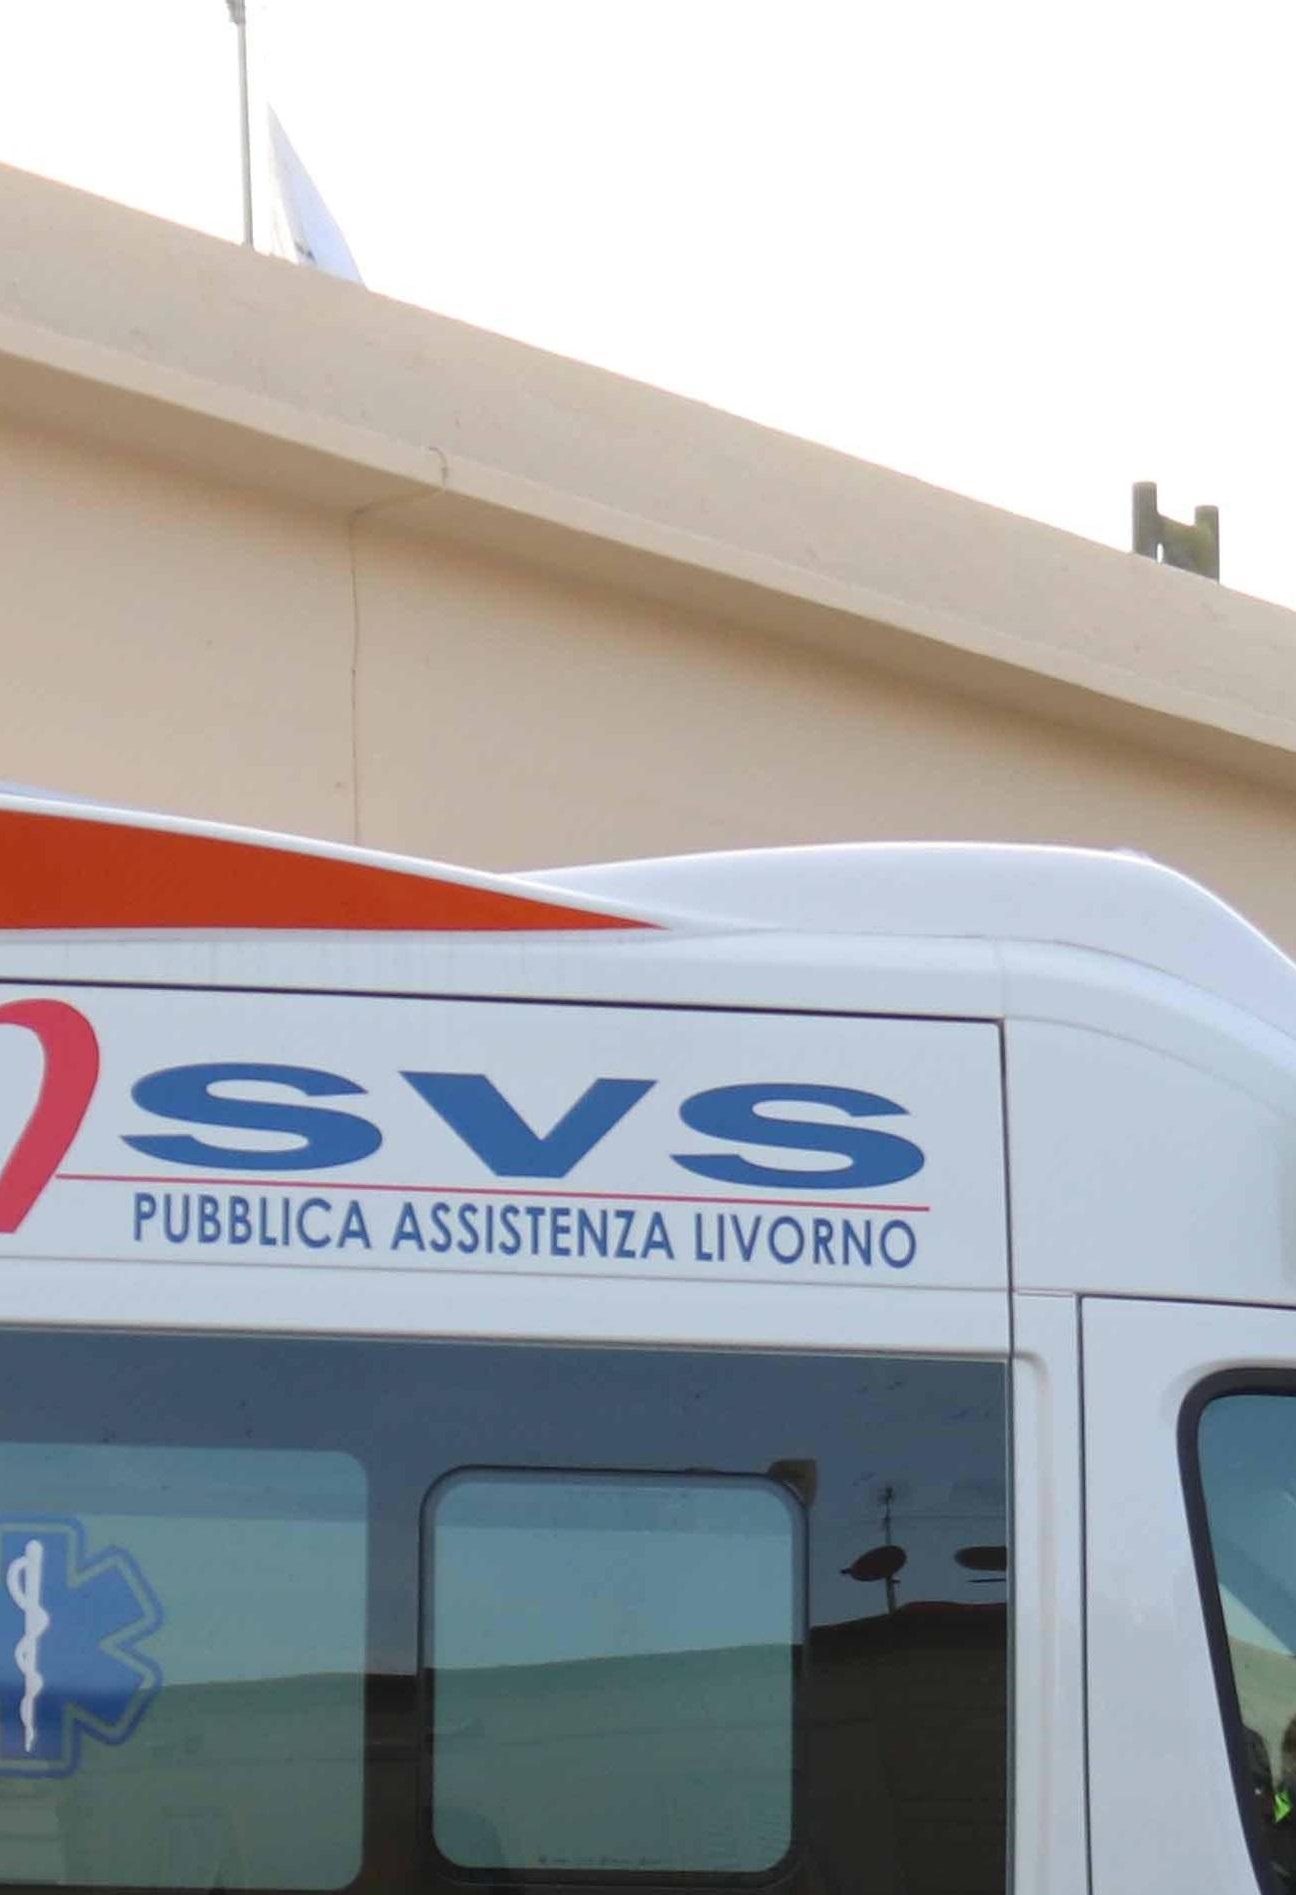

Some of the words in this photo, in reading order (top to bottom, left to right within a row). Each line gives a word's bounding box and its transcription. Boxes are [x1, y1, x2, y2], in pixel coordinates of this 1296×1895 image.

[118, 1061, 926, 1190] SVS
[134, 1192, 368, 1250] PUBBLICA
[390, 1200, 675, 1260] ASSISTENZA
[695, 1211, 918, 1269] LIVORNO
